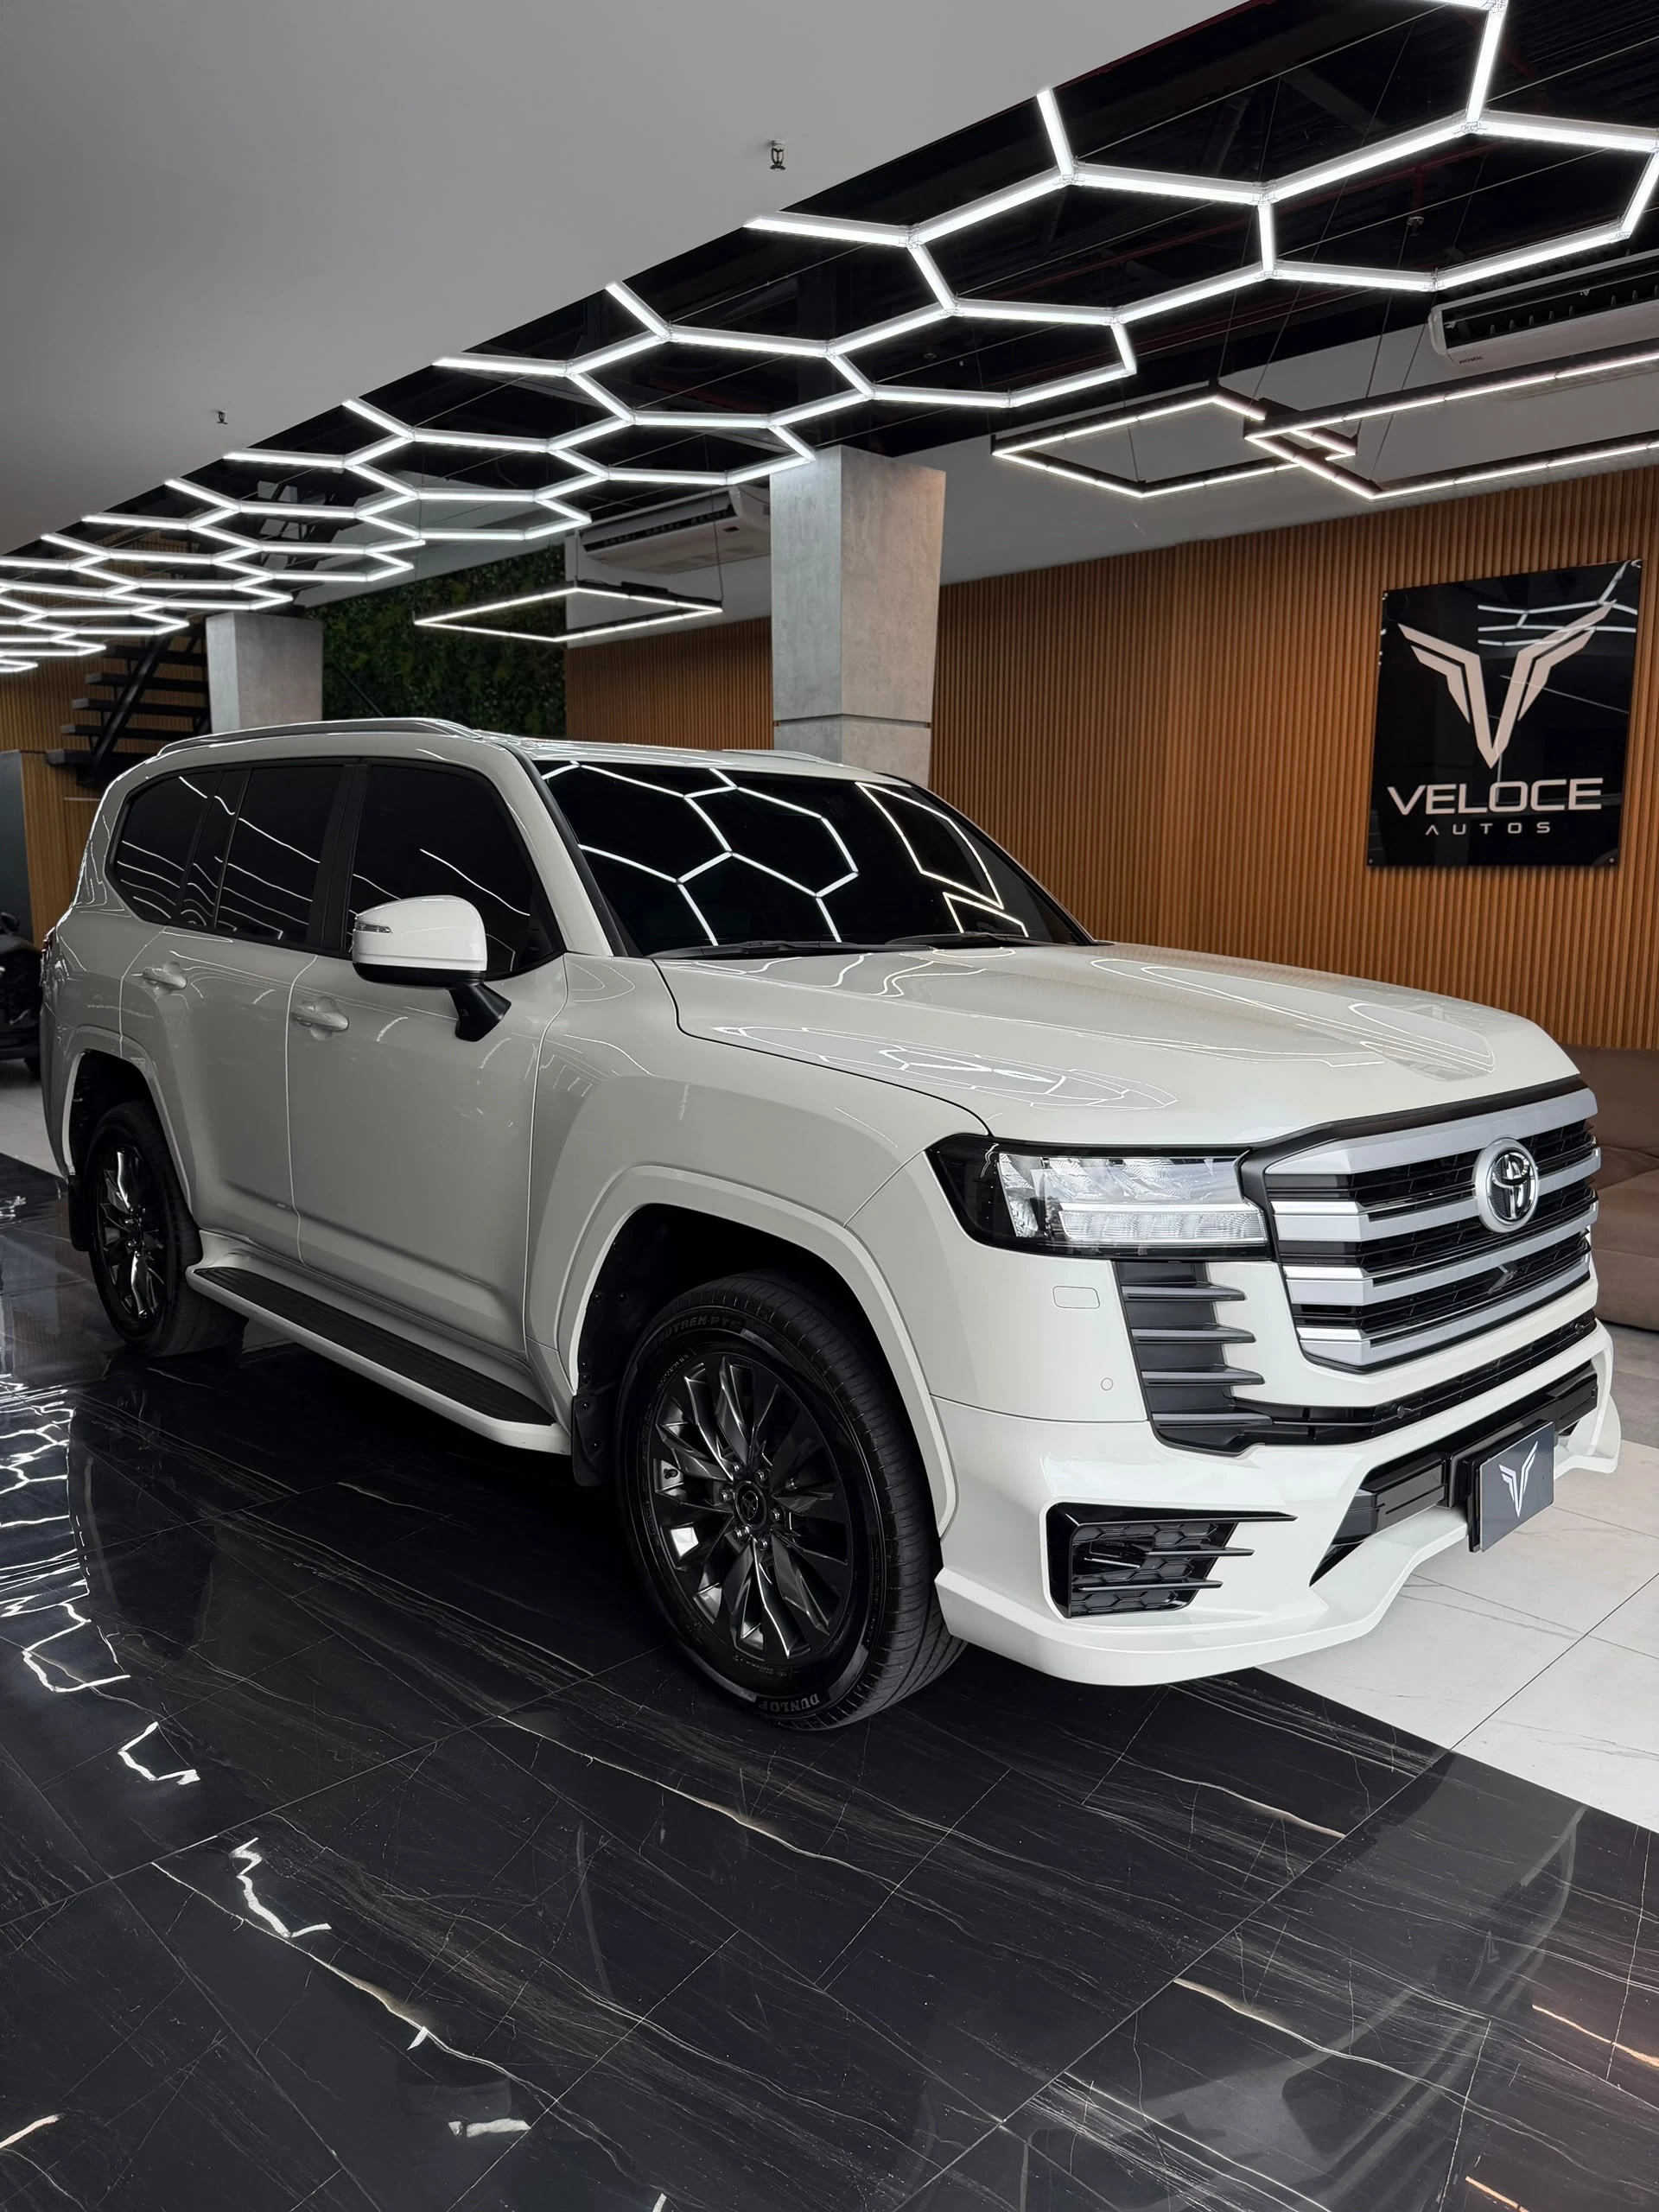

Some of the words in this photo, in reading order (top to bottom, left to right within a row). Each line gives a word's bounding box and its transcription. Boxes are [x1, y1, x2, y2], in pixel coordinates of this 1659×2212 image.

[1387, 778, 1604, 816] VELOCE
[1426, 822, 1551, 836] AUTOS
[758, 1693, 821, 1713] DUNLOP
